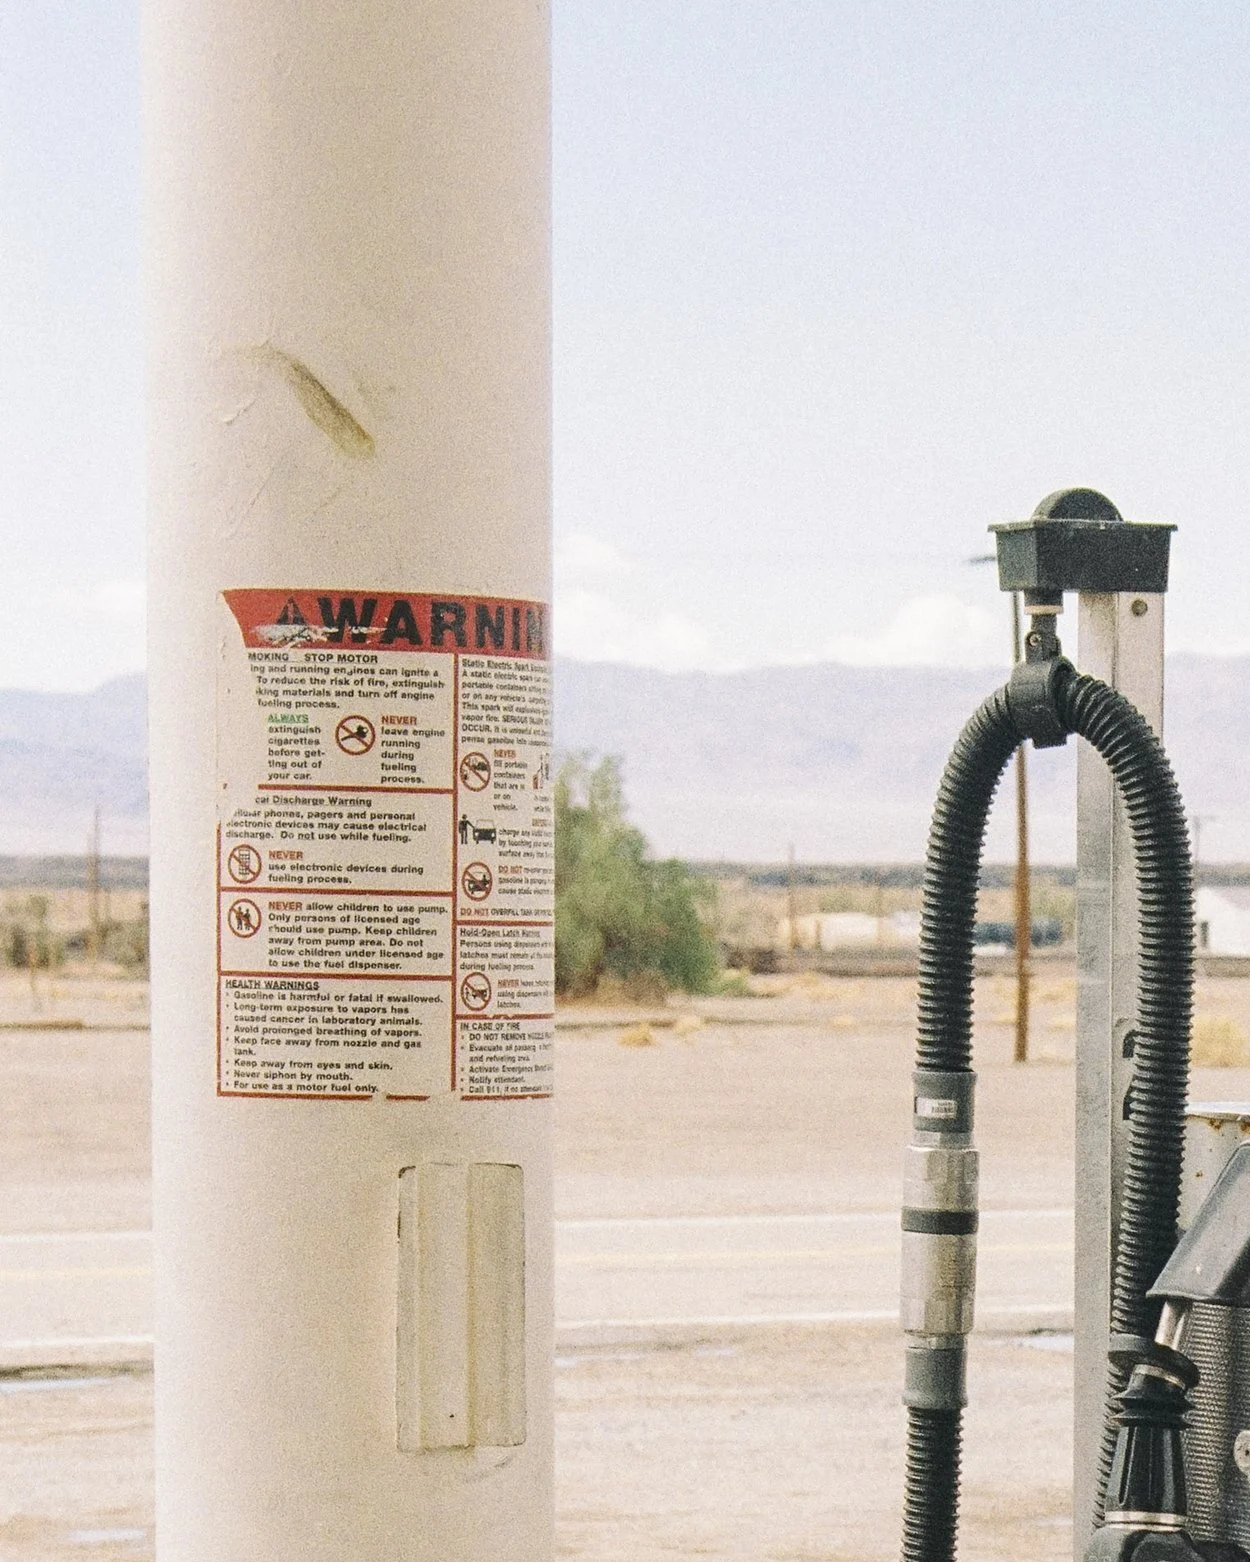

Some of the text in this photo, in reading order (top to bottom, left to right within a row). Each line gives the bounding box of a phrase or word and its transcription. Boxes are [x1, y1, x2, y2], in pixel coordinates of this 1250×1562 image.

[317, 598, 545, 651] WARNIN
[248, 653, 289, 661] MOKING
[305, 654, 378, 663] STOP MOTOR
[271, 677, 305, 685] reduce
[310, 677, 326, 685] the
[330, 678, 350, 686] risk
[354, 678, 364, 686] of
[368, 678, 388, 688] fire,
[393, 680, 445, 689] extinguish
[296, 700, 340, 710] process.
[268, 714, 308, 723] ALWAYS
[381, 716, 417, 725] NEVER
[268, 726, 321, 734] extinguish
[381, 728, 445, 738] leave engine
[268, 737, 320, 745] cigarettes
[381, 740, 420, 749] running
[268, 748, 325, 758] before get-
[381, 752, 414, 761] during
[268, 761, 287, 769] ting
[381, 763, 416, 772] fueling
[268, 772, 311, 781] your car.
[269, 851, 303, 860] NEVER
[290, 863, 343, 872] electronic
[347, 864, 386, 873] devices
[391, 865, 424, 875] during
[269, 874, 352, 885] fueling process.
[269, 902, 448, 914] NEVER allow children to use pump.
[269, 913, 420, 926] Only persons of licensed age
[269, 937, 293, 945] away
[298, 937, 322, 945] from
[326, 938, 355, 947] pump
[390, 938, 403, 947] Do
[407, 939, 423, 947] not
[304, 960, 321, 968] the
[325, 960, 344, 968] fuel
[349, 961, 402, 971] dispenser.
[226, 980, 319, 990] HEALTH WARNINGS
[234, 991, 274, 1000] Gasoline
[278, 992, 286, 1000] is
[290, 992, 330, 1001] harmful
[349, 993, 373, 1002] fatal
[377, 994, 383, 1002] if
[388, 995, 443, 1003] swallowed.
[234, 1002, 409, 1015] Long-term exposure to vapors has
[234, 1026, 421, 1038] Avoid prolonged breathing of vapors.
[234, 1037, 421, 1050] Keep face away from nozzle and gas
[234, 1059, 393, 1071] Keep away from eyes and skin.
[234, 1070, 353, 1082] Never siphon by mouth.
[234, 1081, 248, 1089] For
[297, 1084, 327, 1092] motor
[331, 1083, 351, 1092] fuel
[355, 1083, 379, 1094] only.
